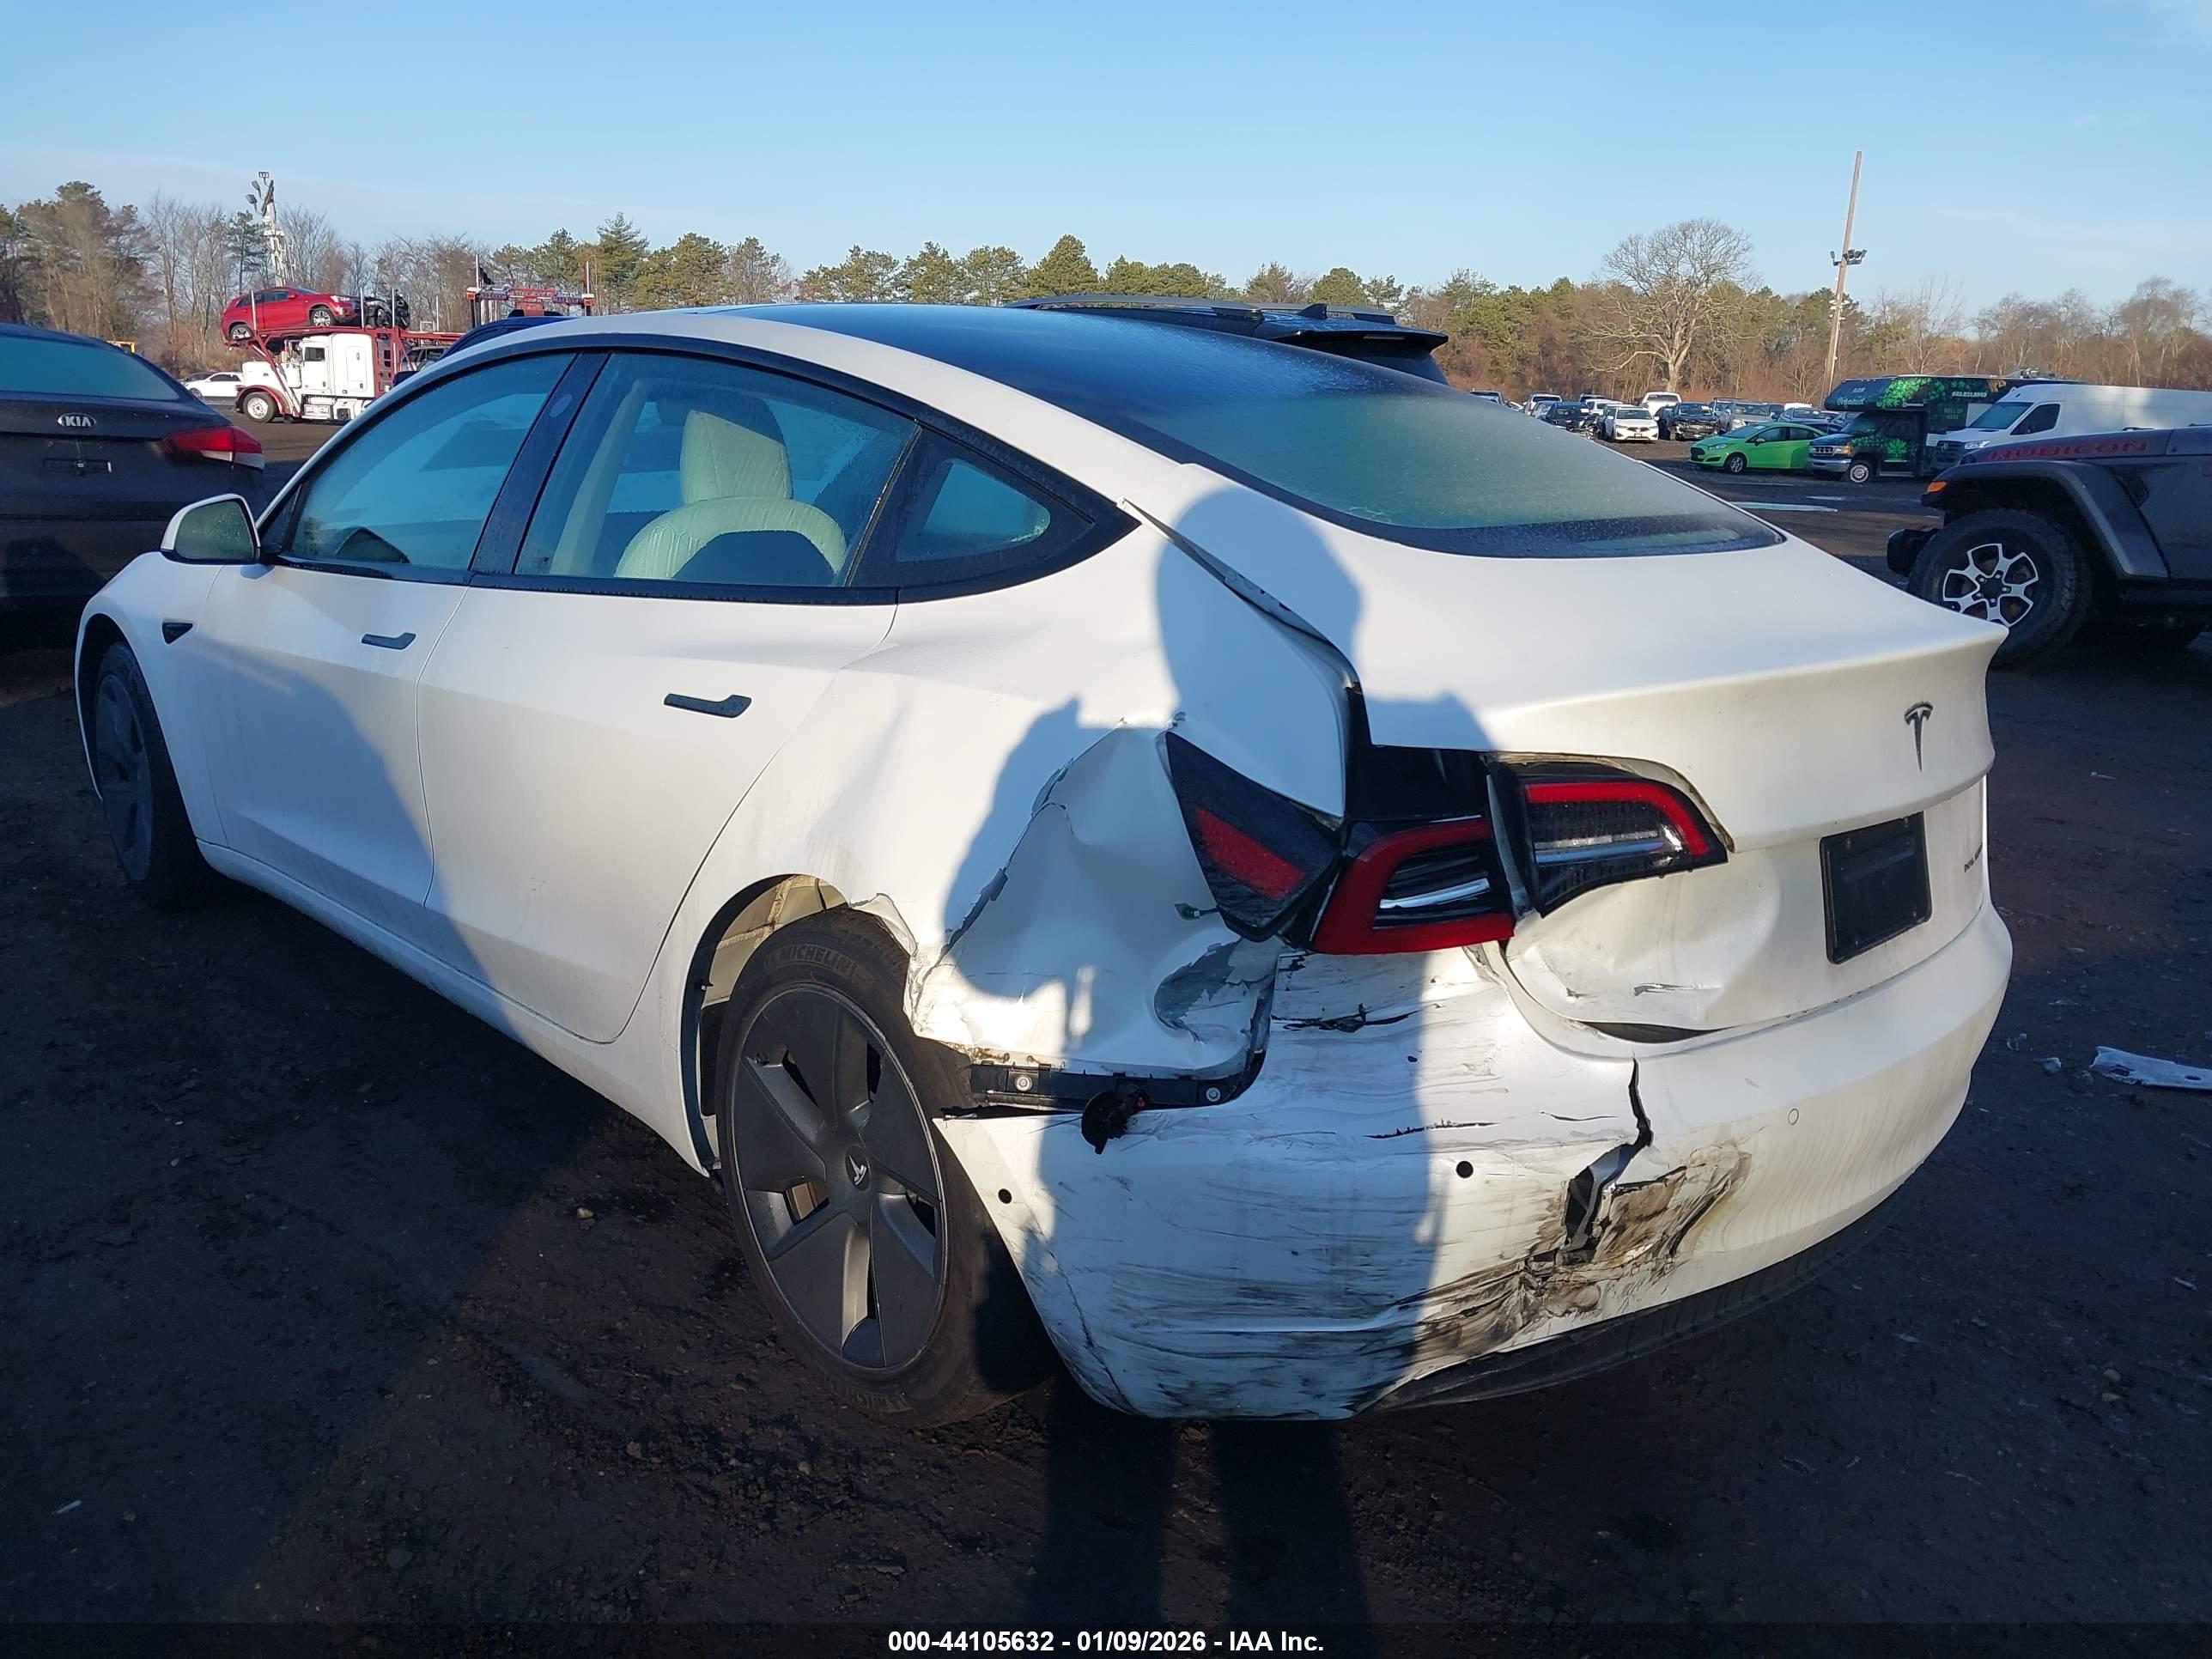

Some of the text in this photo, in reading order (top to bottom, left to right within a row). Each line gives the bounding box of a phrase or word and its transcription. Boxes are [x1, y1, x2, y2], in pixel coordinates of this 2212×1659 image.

[64, 416, 92, 427] KIA
[1987, 440, 2151, 461] RUBICON
[778, 945, 852, 975] MICHELIN
